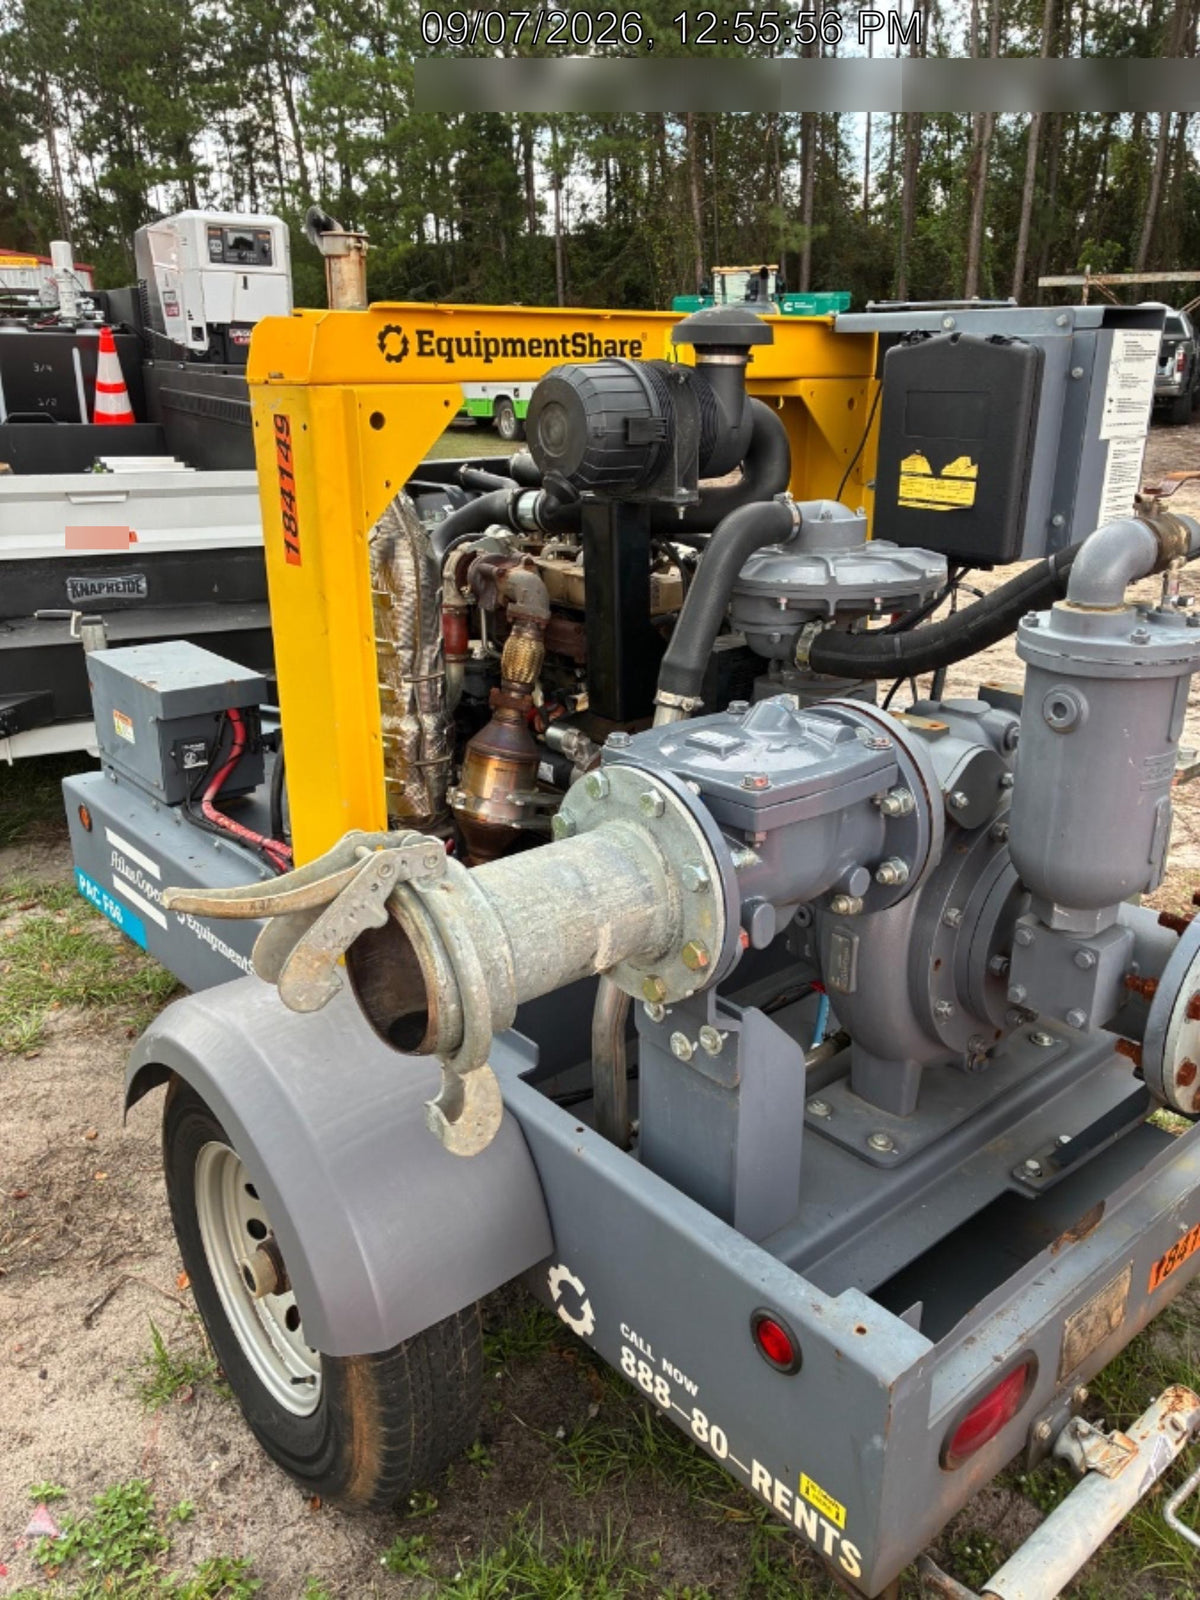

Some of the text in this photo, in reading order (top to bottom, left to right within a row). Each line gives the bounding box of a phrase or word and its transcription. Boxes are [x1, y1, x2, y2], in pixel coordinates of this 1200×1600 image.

[415, 329, 643, 364] EquipmentShare
[273, 413, 301, 556] 184149
[71, 579, 145, 599] KNAPHEIDE
[78, 872, 102, 907] PAC
[1155, 1223, 1200, 1288] 1841
[619, 1322, 699, 1398] CALL NOW
